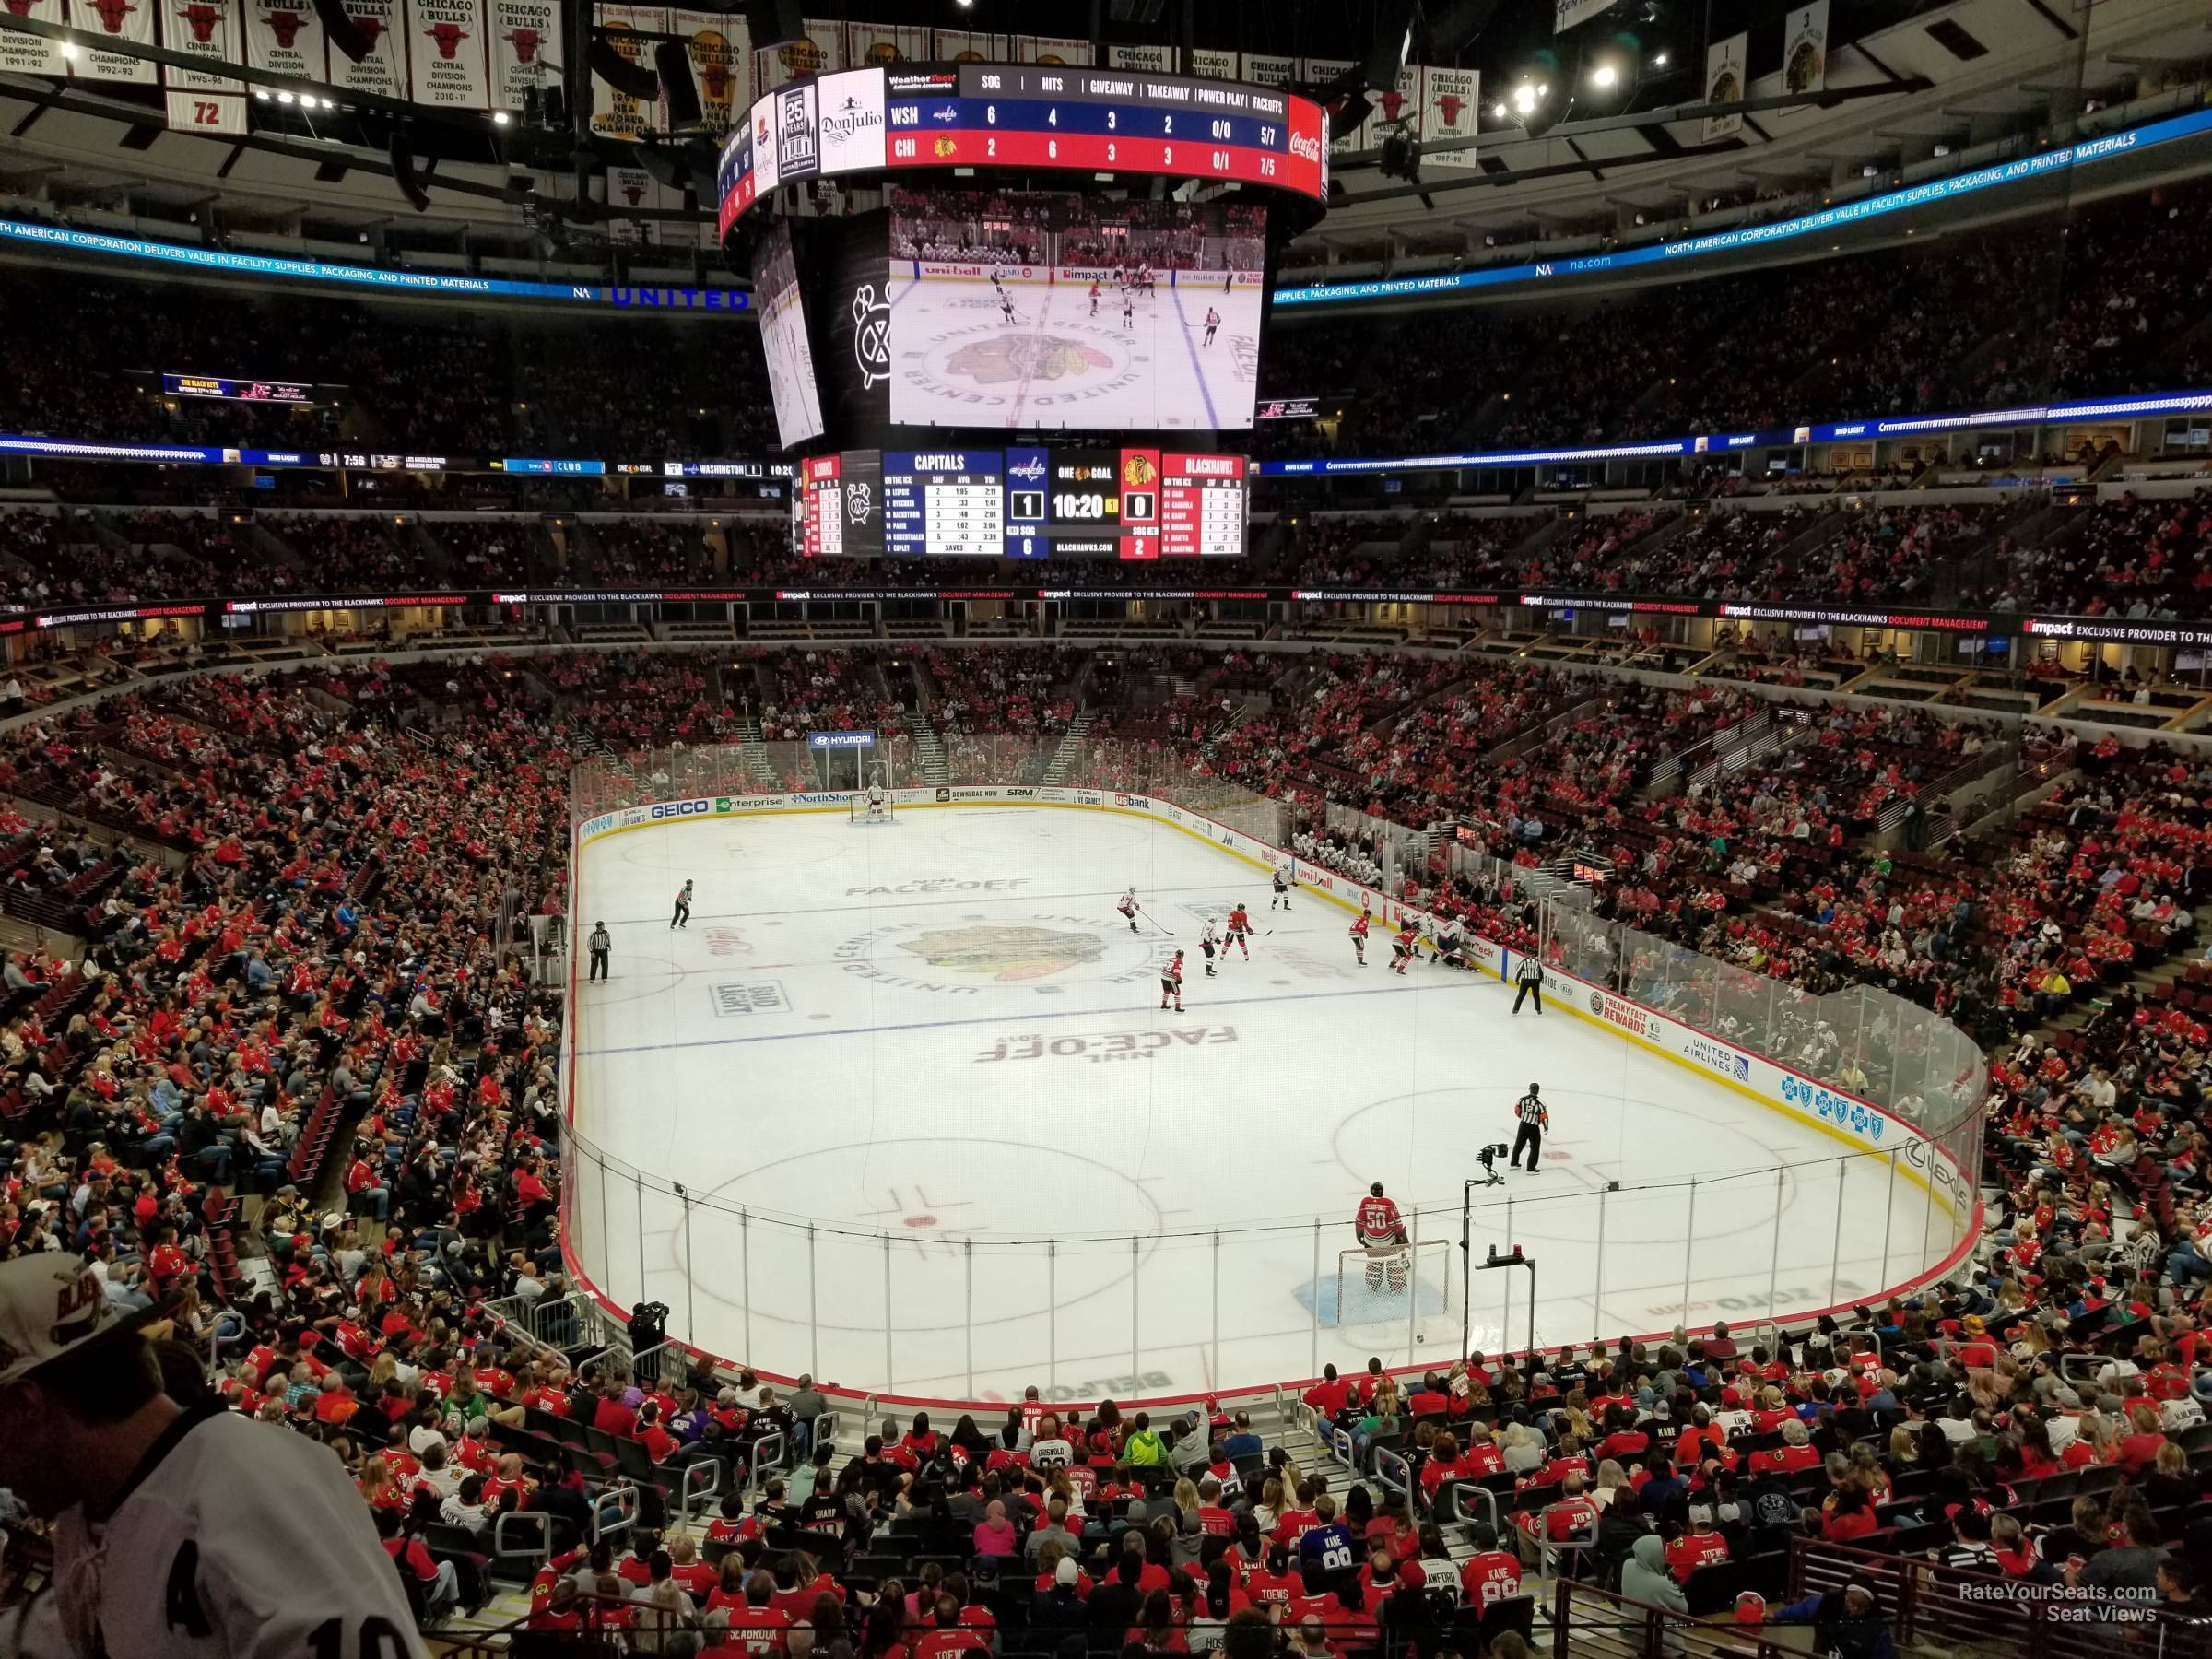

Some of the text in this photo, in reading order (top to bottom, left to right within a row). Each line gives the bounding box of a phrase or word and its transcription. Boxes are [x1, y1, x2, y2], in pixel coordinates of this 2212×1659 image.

[347, 5, 385, 16] BULLS
[498, 3, 551, 16] CHICAGO
[427, 10, 466, 22] BULLS
[506, 17, 544, 28] BULLS
[2, 36, 41, 46] DIVISION
[186, 42, 221, 52] CENTRAL
[89, 54, 140, 65] CHAMPIONS
[269, 51, 302, 59] CENTRAL
[6, 58, 42, 67] 1991-92
[269, 61, 304, 69] DIVISION
[432, 62, 464, 70] CENTRAL
[97, 65, 133, 76] 1992-93
[351, 66, 385, 75] DIVISION
[431, 72, 465, 80] DIVISION
[346, 76, 392, 85] CHAMPIONS
[889, 74, 956, 84] WeatherTech
[1431, 74, 1472, 84] CHICAGO
[427, 81, 472, 91] CHAMPIONS
[1436, 84, 1466, 93] BULLS
[435, 93, 465, 101] 2010-11
[982, 76, 1282, 113] SOG HITS GIVEAWAY TAKEAWAY POWER PLAY FACEOFFS
[194, 102, 219, 124] 72
[614, 103, 635, 112] NBA
[786, 100, 803, 122] 25
[605, 114, 644, 124] WORLD
[787, 122, 804, 133] YEARS
[891, 106, 1275, 146] WSH 6 4 3 2 0/0 5/7
[896, 138, 1275, 176] CHI 2 6 3 3 0/1 7/5
[1665, 134, 2136, 255] NORTH AMERICAN CORPORATION DELIVERS VALUE IN FACILITY SUPPLIES, PACKAGING, AND PRINTED MATERIALS
[15, 225, 69, 241] AMERICAN
[72, 234, 142, 252] CORPORATION
[145, 245, 185, 258] DELIVERS
[187, 252, 215, 263] VALUE
[218, 256, 229, 265] IN
[232, 257, 272, 269] FACILITY
[276, 262, 319, 275] SUPPLIES,
[321, 266, 376, 280] PACKAGING,
[379, 272, 397, 282] AND
[400, 276, 437, 286] PRINTED
[441, 278, 488, 289] MATERIALS
[573, 288, 590, 298] NA
[1311, 256, 1611, 298] PACKAGING, AND PRINTED MATERIALS NA na.com
[612, 286, 748, 311] UNITED
[344, 455, 365, 465] 7:56
[914, 455, 964, 470] CAPITALS
[558, 463, 581, 471] CLUB
[700, 464, 745, 475] WASHINGTON
[1186, 459, 1233, 475] BLACKHAWKS
[1059, 468, 1112, 479] ONE GOAL
[1023, 495, 1144, 517] 1 10:20 0
[1020, 526, 1035, 535] SOG
[1023, 539, 1031, 554] 6
[1135, 539, 1144, 554] 2
[1044, 590, 1071, 598] impact
[232, 602, 256, 611] impact
[258, 601, 288, 609] EXCLUSIVE
[289, 600, 320, 608] PROVIDER
[344, 598, 383, 606] BLACKHAWKS
[1725, 605, 1751, 617] impact
[1753, 608, 1784, 618] EXCLUSIVE
[1786, 610, 1816, 618] PROVIDER
[1827, 612, 1840, 620] THE
[1841, 613, 1888, 623] BLACKHAWKS
[1889, 616, 1930, 626] DOCUMENT
[1932, 618, 1988, 629] MANAGEMENT
[2031, 620, 2194, 641] impact EXCLUSIVE PROVIDER TO
[830, 735, 871, 745] HYUNDAI
[717, 797, 782, 811] enterprise
[1128, 796, 1149, 809] bank
[652, 801, 708, 818] GEICO
[1262, 849, 1278, 866] meijer
[1606, 998, 1647, 1022] FREAKY FAST
[1604, 1007, 1645, 1035] REWARDS
[973, 1027, 1237, 1063] FACE-OFF
[1694, 1040, 1731, 1061] UNITED
[1684, 1046, 1730, 1072] AIRLINES
[1928, 1155, 1966, 1210] LEXUS
[1366, 1211, 1385, 1229] 50
[1658, 1428, 1676, 1437] KANE
[1484, 1457, 1499, 1465] HALL
[1441, 1471, 1456, 1480] KANE
[816, 1509, 836, 1519] SHARP
[1324, 1535, 1342, 1548] KANE
[1701, 1549, 1724, 1560] TOEWS
[1488, 1568, 1509, 1580] KANE
[1262, 1589, 1288, 1600] TOEWS
[730, 1629, 777, 1640] SEABROOK
